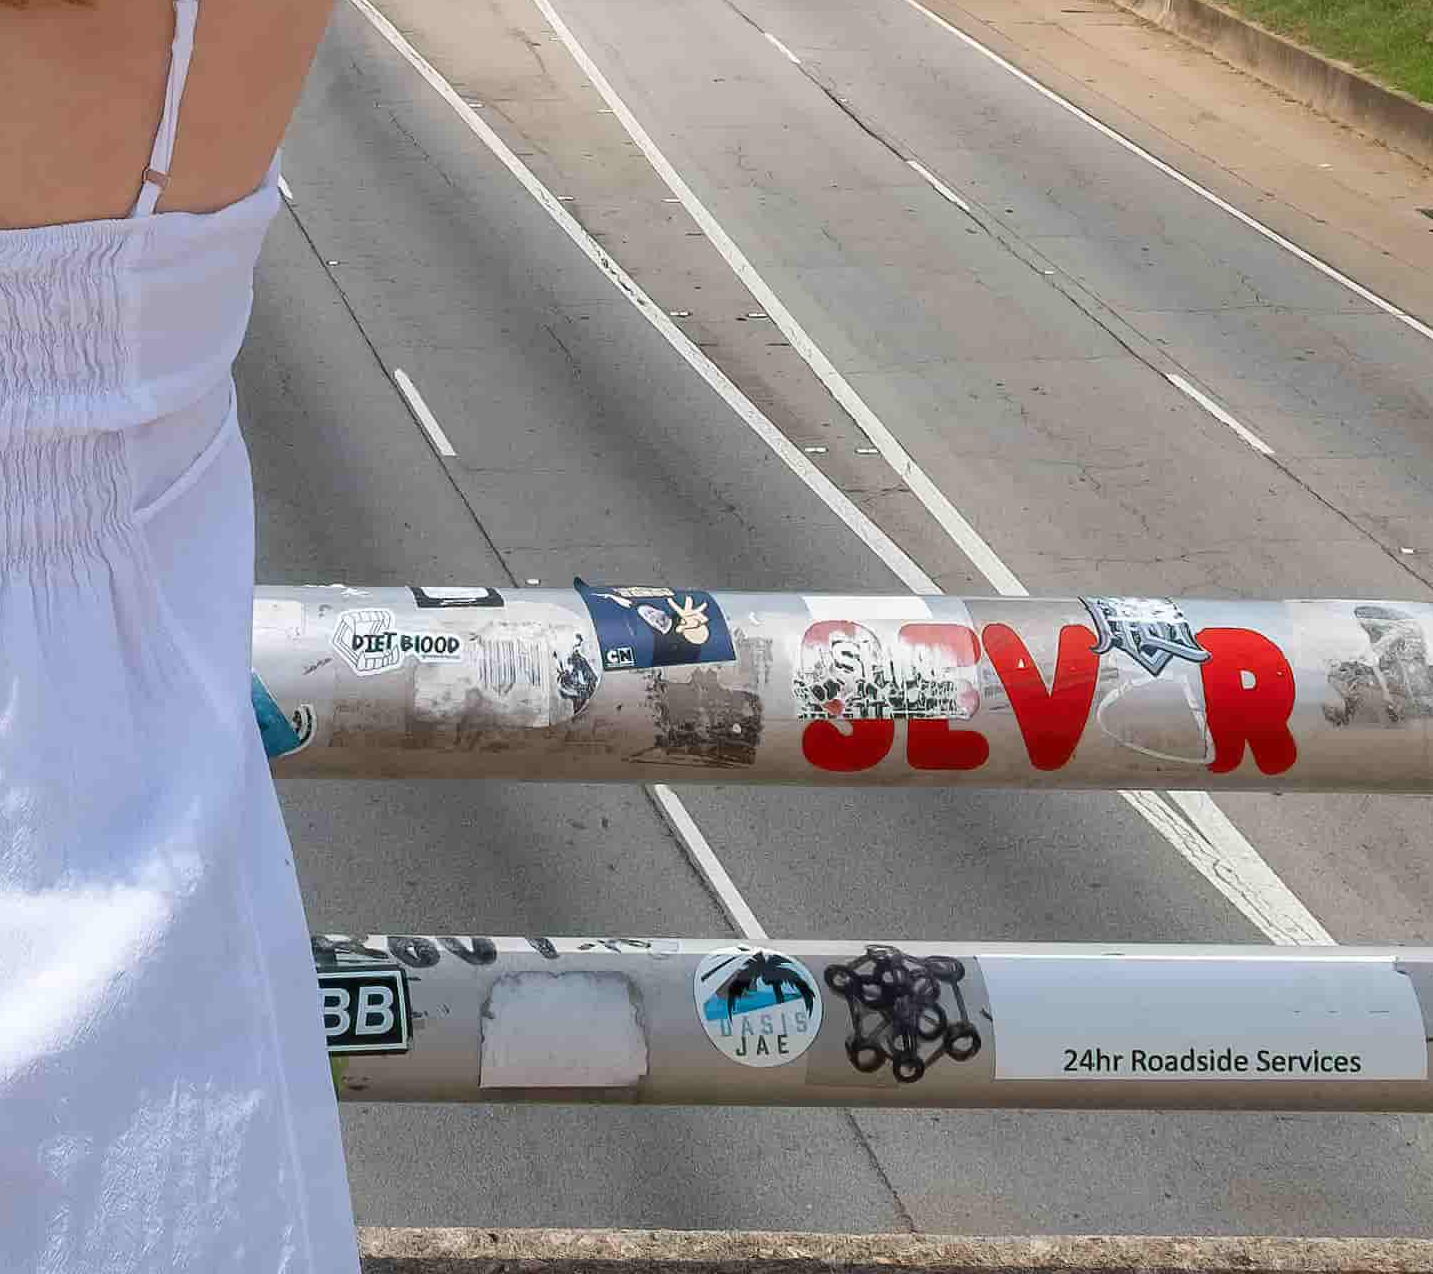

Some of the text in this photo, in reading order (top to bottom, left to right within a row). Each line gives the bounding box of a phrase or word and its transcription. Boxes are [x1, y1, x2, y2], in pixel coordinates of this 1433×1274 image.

[352, 631, 397, 653] DIET
[606, 646, 634, 664] CN
[736, 1033, 790, 1057] JAE
[1063, 1047, 1362, 1074] 24hr Roadside Services
